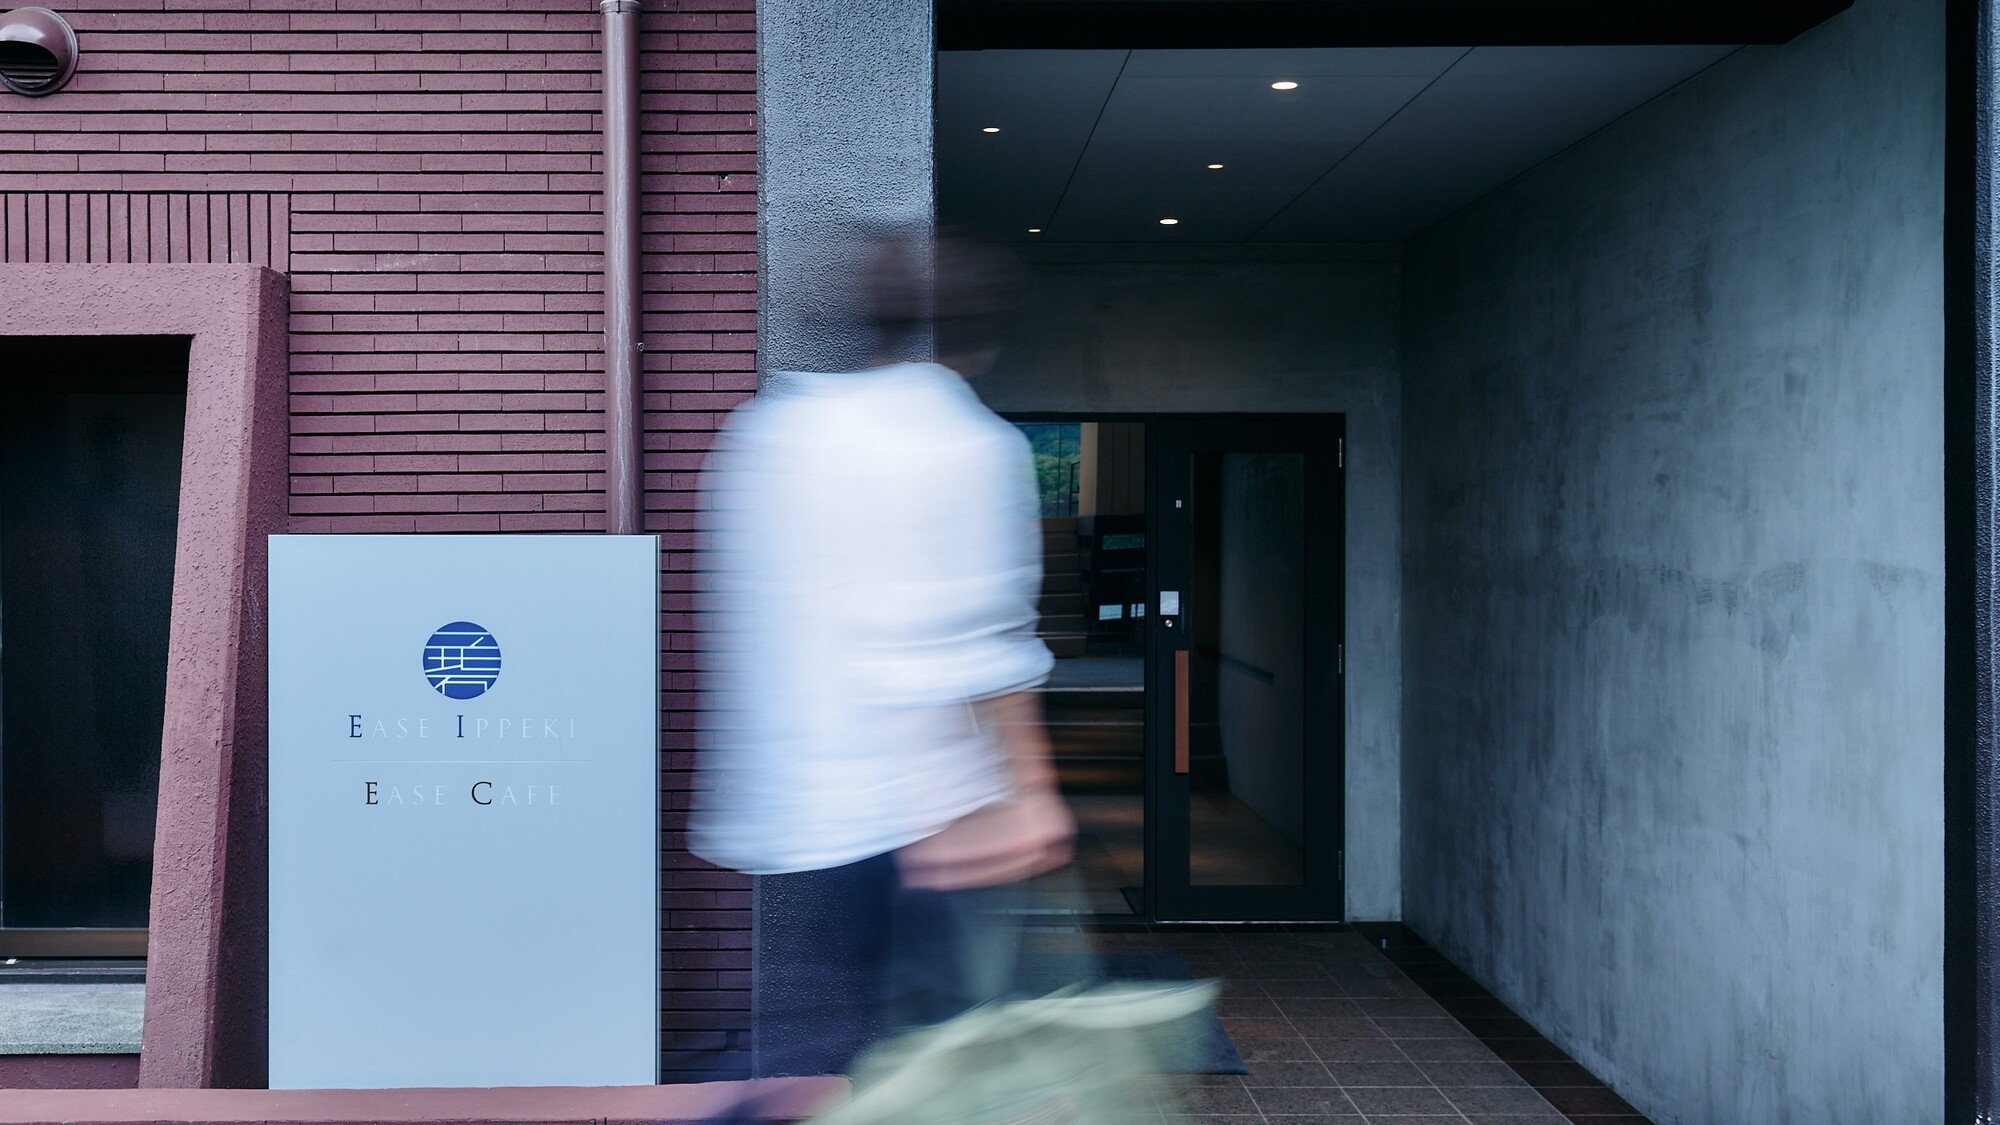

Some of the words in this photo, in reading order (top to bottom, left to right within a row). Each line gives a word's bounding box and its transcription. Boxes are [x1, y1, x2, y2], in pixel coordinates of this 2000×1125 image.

[348, 714, 432, 738] EASE
[456, 714, 576, 738] IPPEKI
[364, 781, 448, 805] EASE
[471, 781, 561, 805] CAFE
